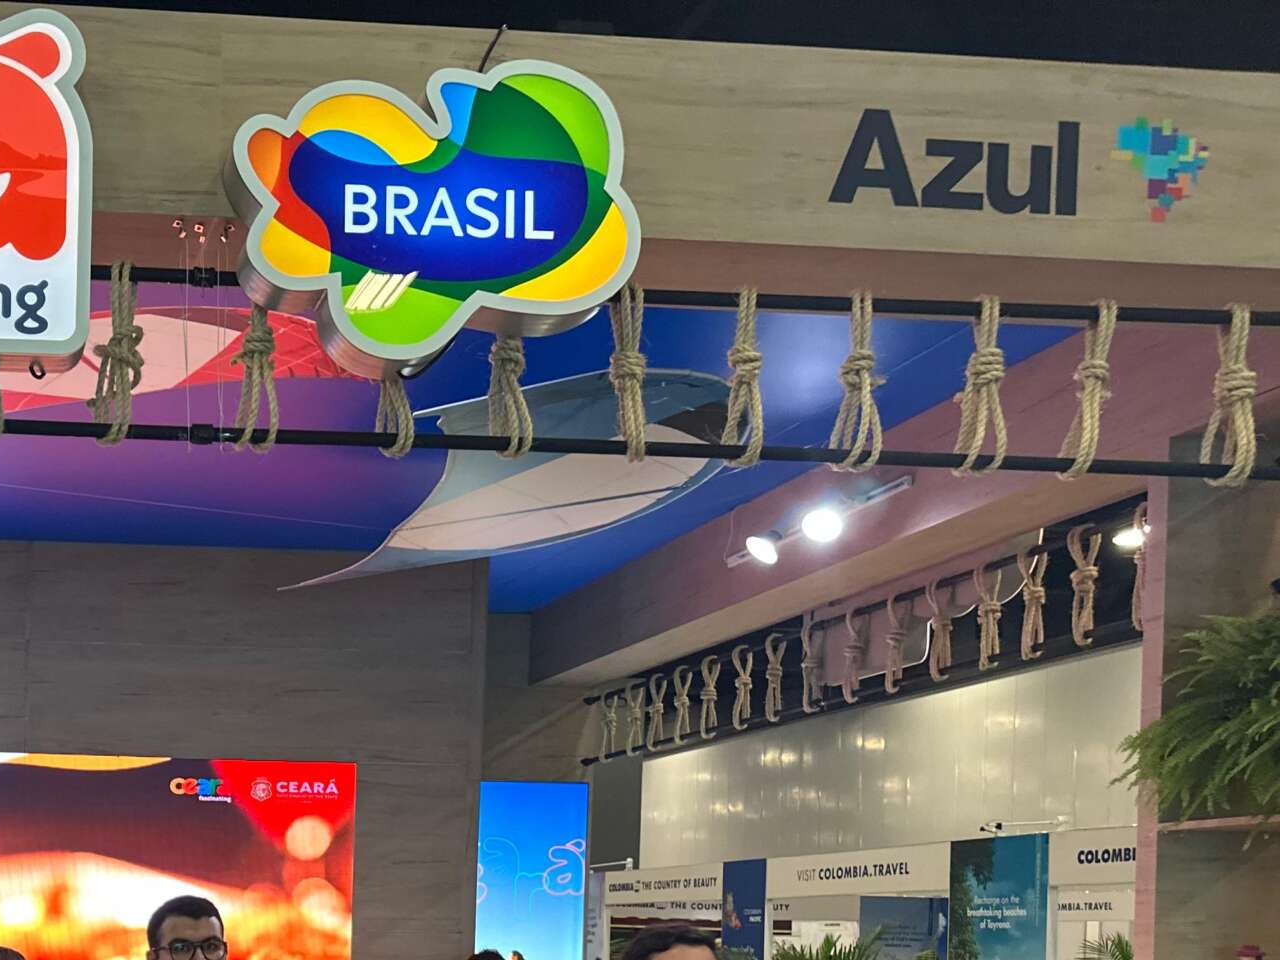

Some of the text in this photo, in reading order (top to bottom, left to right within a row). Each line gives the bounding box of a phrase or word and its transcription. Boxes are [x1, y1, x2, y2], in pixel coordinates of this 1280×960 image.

[828, 108, 1080, 216] Azul
[343, 184, 555, 240] BRASIL
[276, 779, 339, 794] CEARÁ
[1077, 848, 1136, 864] COLOMBI
[797, 862, 910, 881] VISIT COLOMBIA.TRAVEL
[642, 881, 652, 890] THE
[653, 880, 681, 890] COUNTRY
[683, 880, 691, 888] OF
[694, 877, 717, 887] BEAUTY
[670, 901, 687, 909] THE
